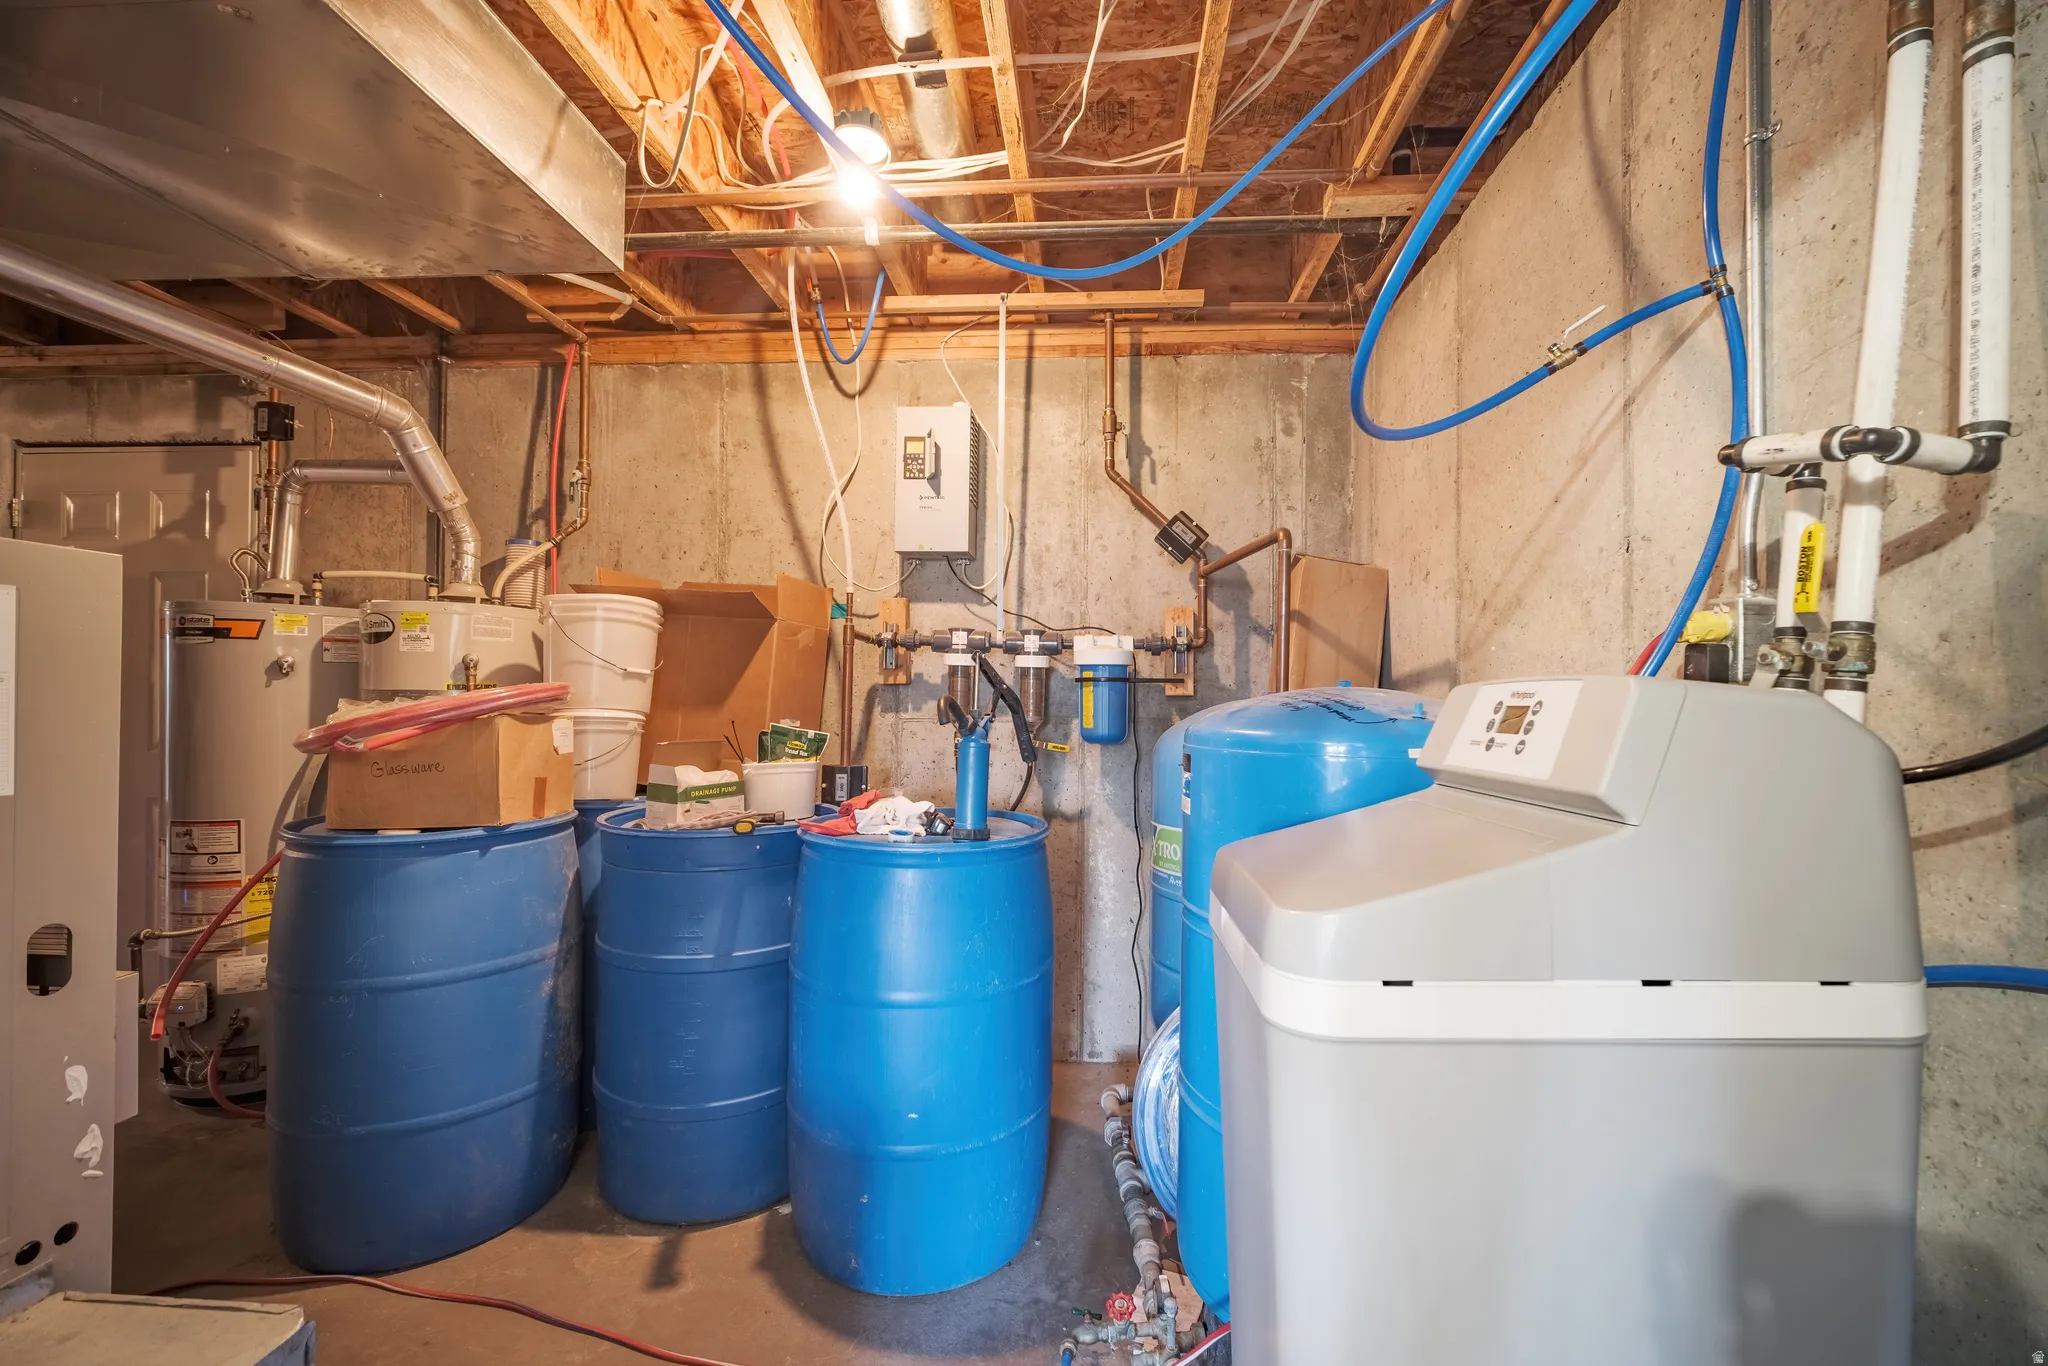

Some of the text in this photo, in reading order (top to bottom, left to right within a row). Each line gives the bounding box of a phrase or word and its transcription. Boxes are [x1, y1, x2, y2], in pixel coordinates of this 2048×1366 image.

[1796, 546, 1808, 582] BOSTON
[690, 785, 737, 797] DRAINAGE PUMP
